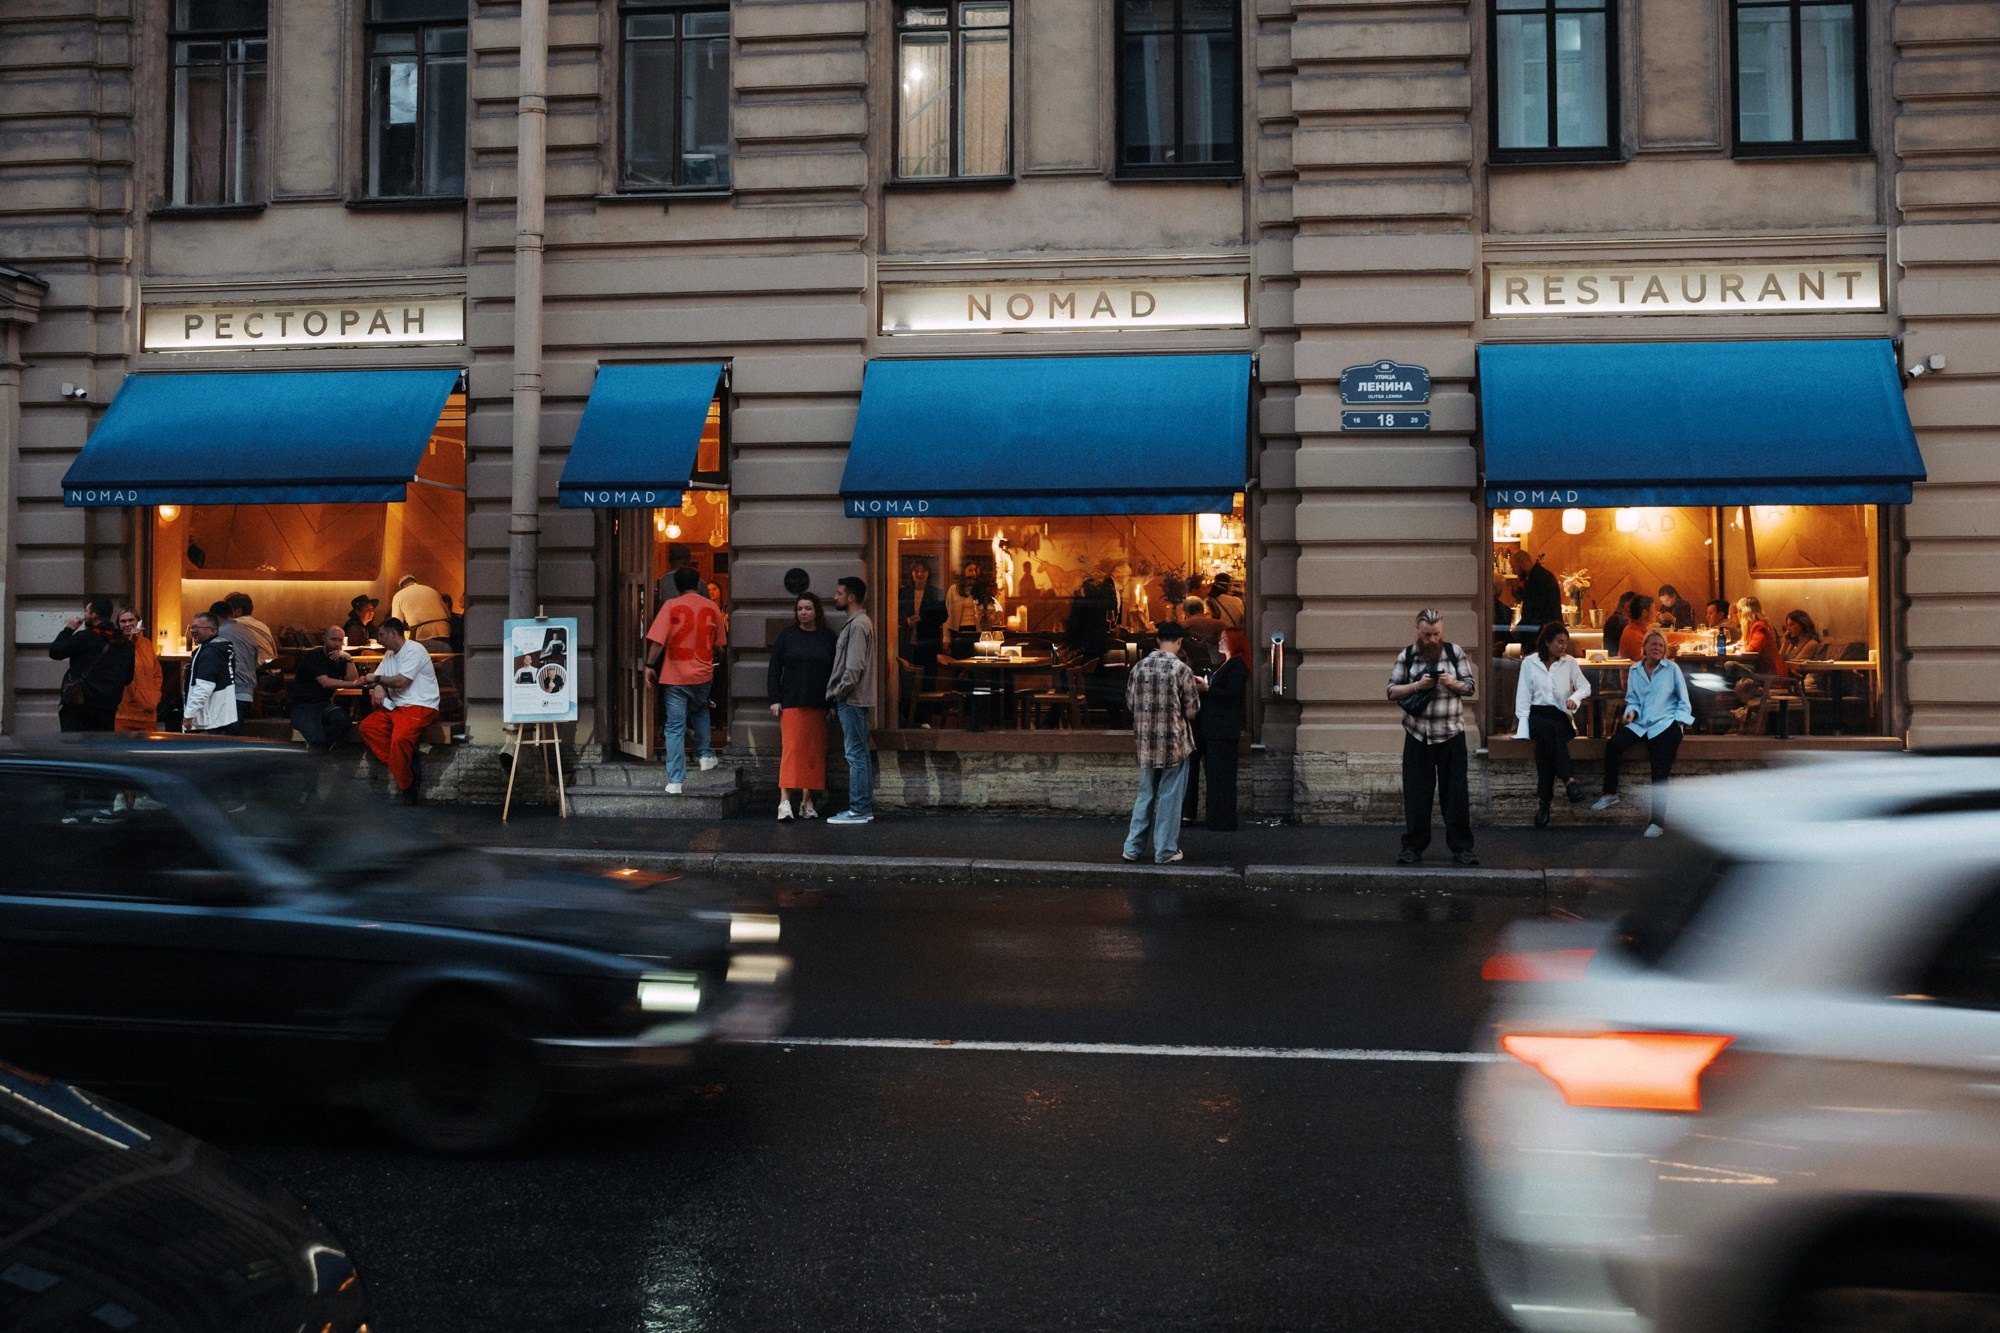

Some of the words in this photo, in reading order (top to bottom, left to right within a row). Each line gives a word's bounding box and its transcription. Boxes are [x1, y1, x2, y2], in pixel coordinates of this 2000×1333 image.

[1505, 270, 1863, 306] RESTAURANT
[967, 290, 1157, 321] NOMAD
[184, 307, 425, 340] РЕСТОРАН
[1357, 381, 1414, 392] ЛЕНИНА
[1377, 414, 1395, 427] 18
[72, 490, 138, 501] NOMAD
[584, 491, 656, 503] NOMAD
[1497, 490, 1578, 503] NOMAD
[854, 500, 929, 512] NOMAD
